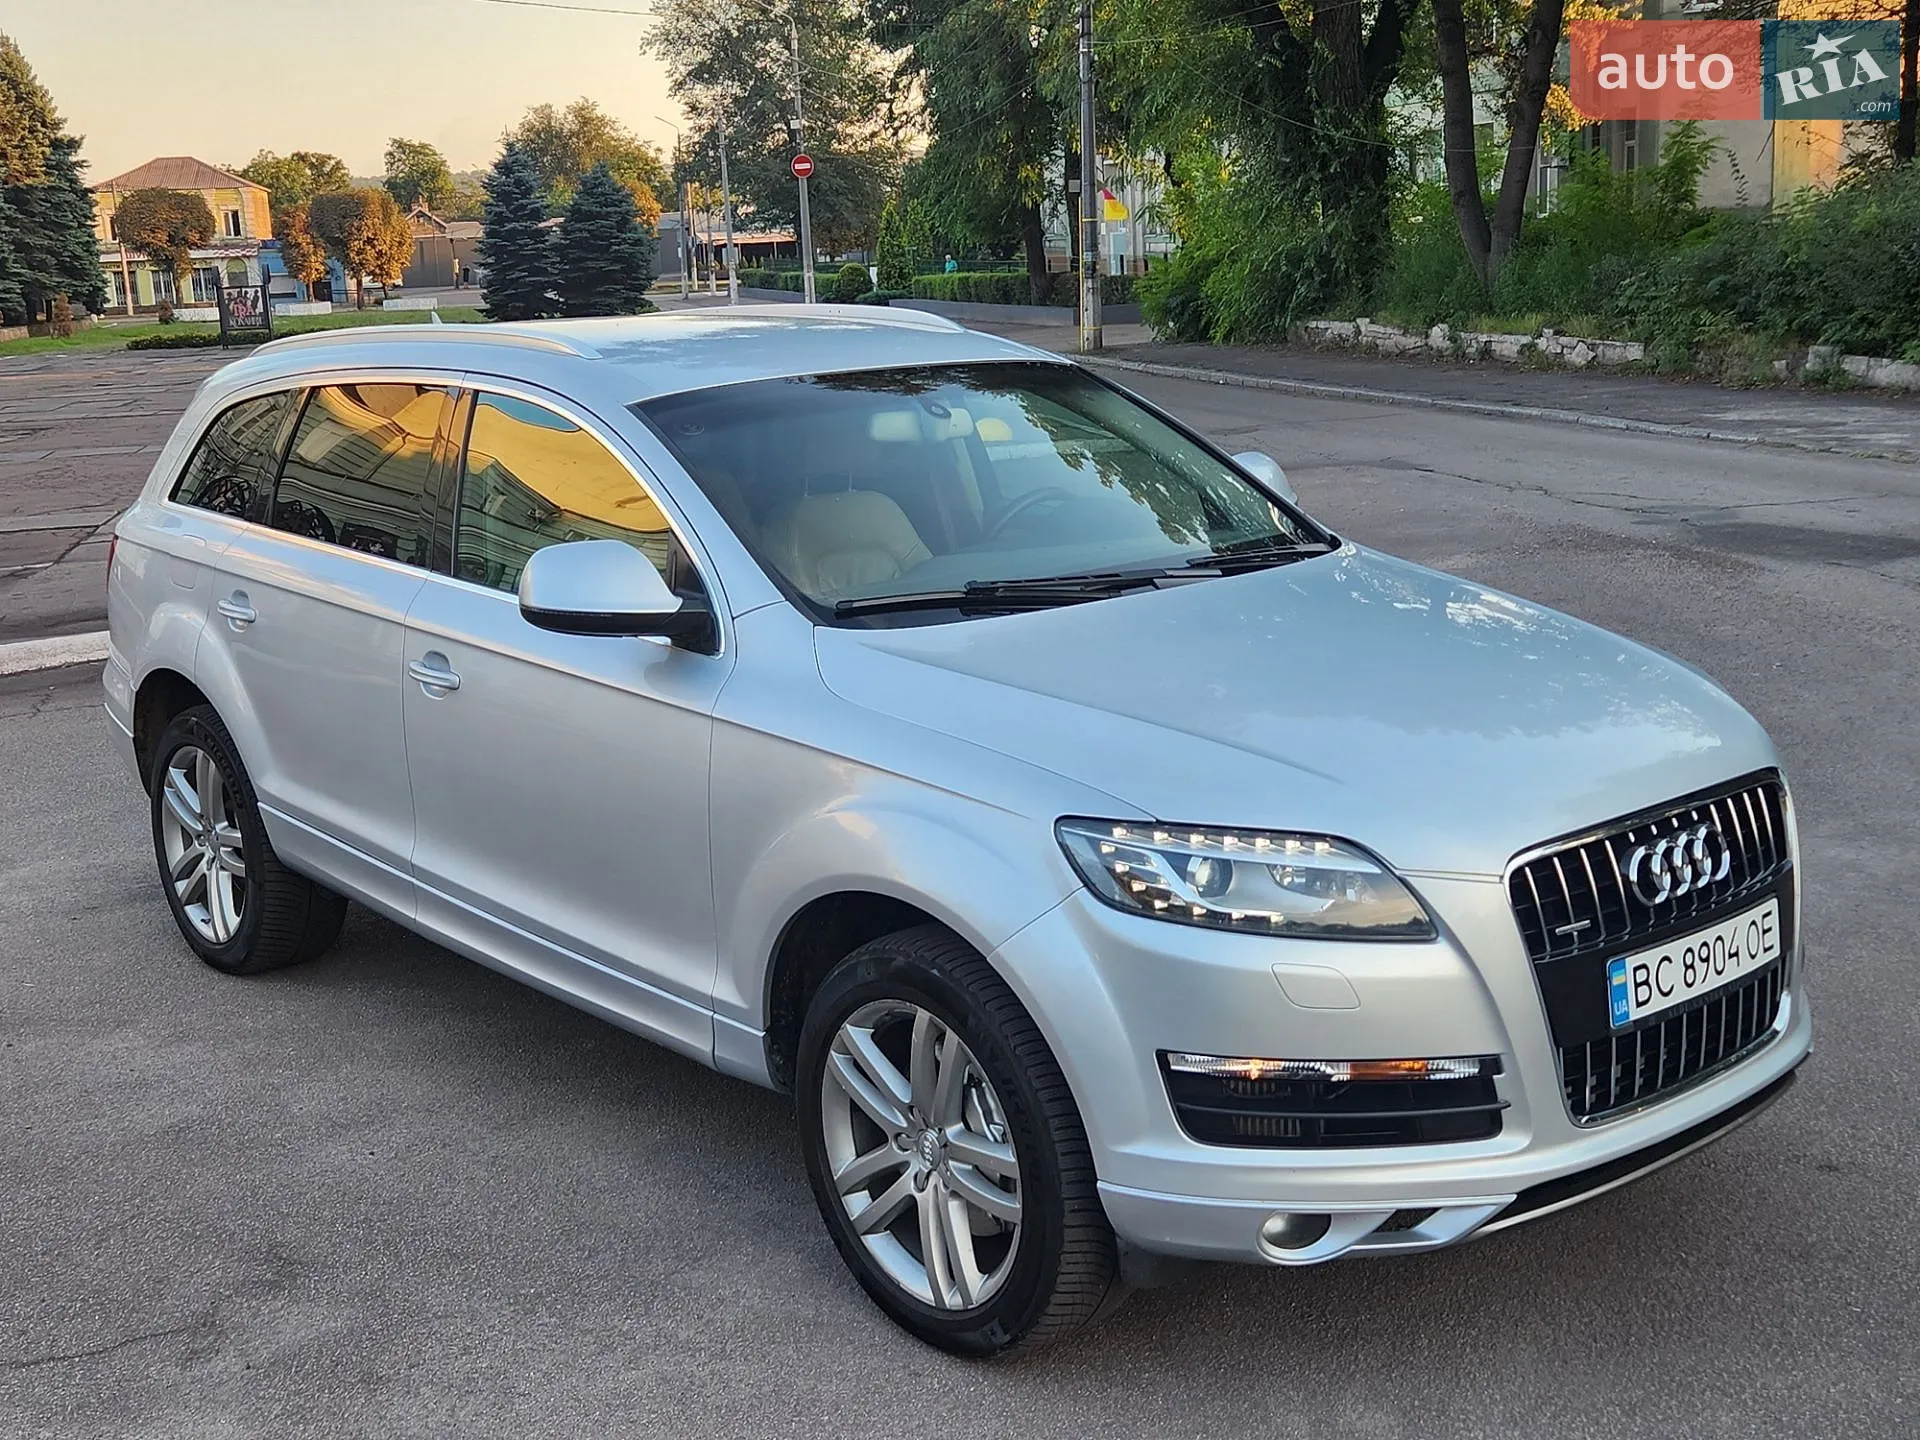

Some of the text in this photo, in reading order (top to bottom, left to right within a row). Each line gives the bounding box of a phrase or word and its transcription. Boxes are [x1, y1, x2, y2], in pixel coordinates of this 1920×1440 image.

[1632, 955, 1675, 1009] BC
[1682, 926, 1740, 989] 8904
[1747, 910, 1775, 960] OE
[1613, 1001, 1628, 1016] UA
